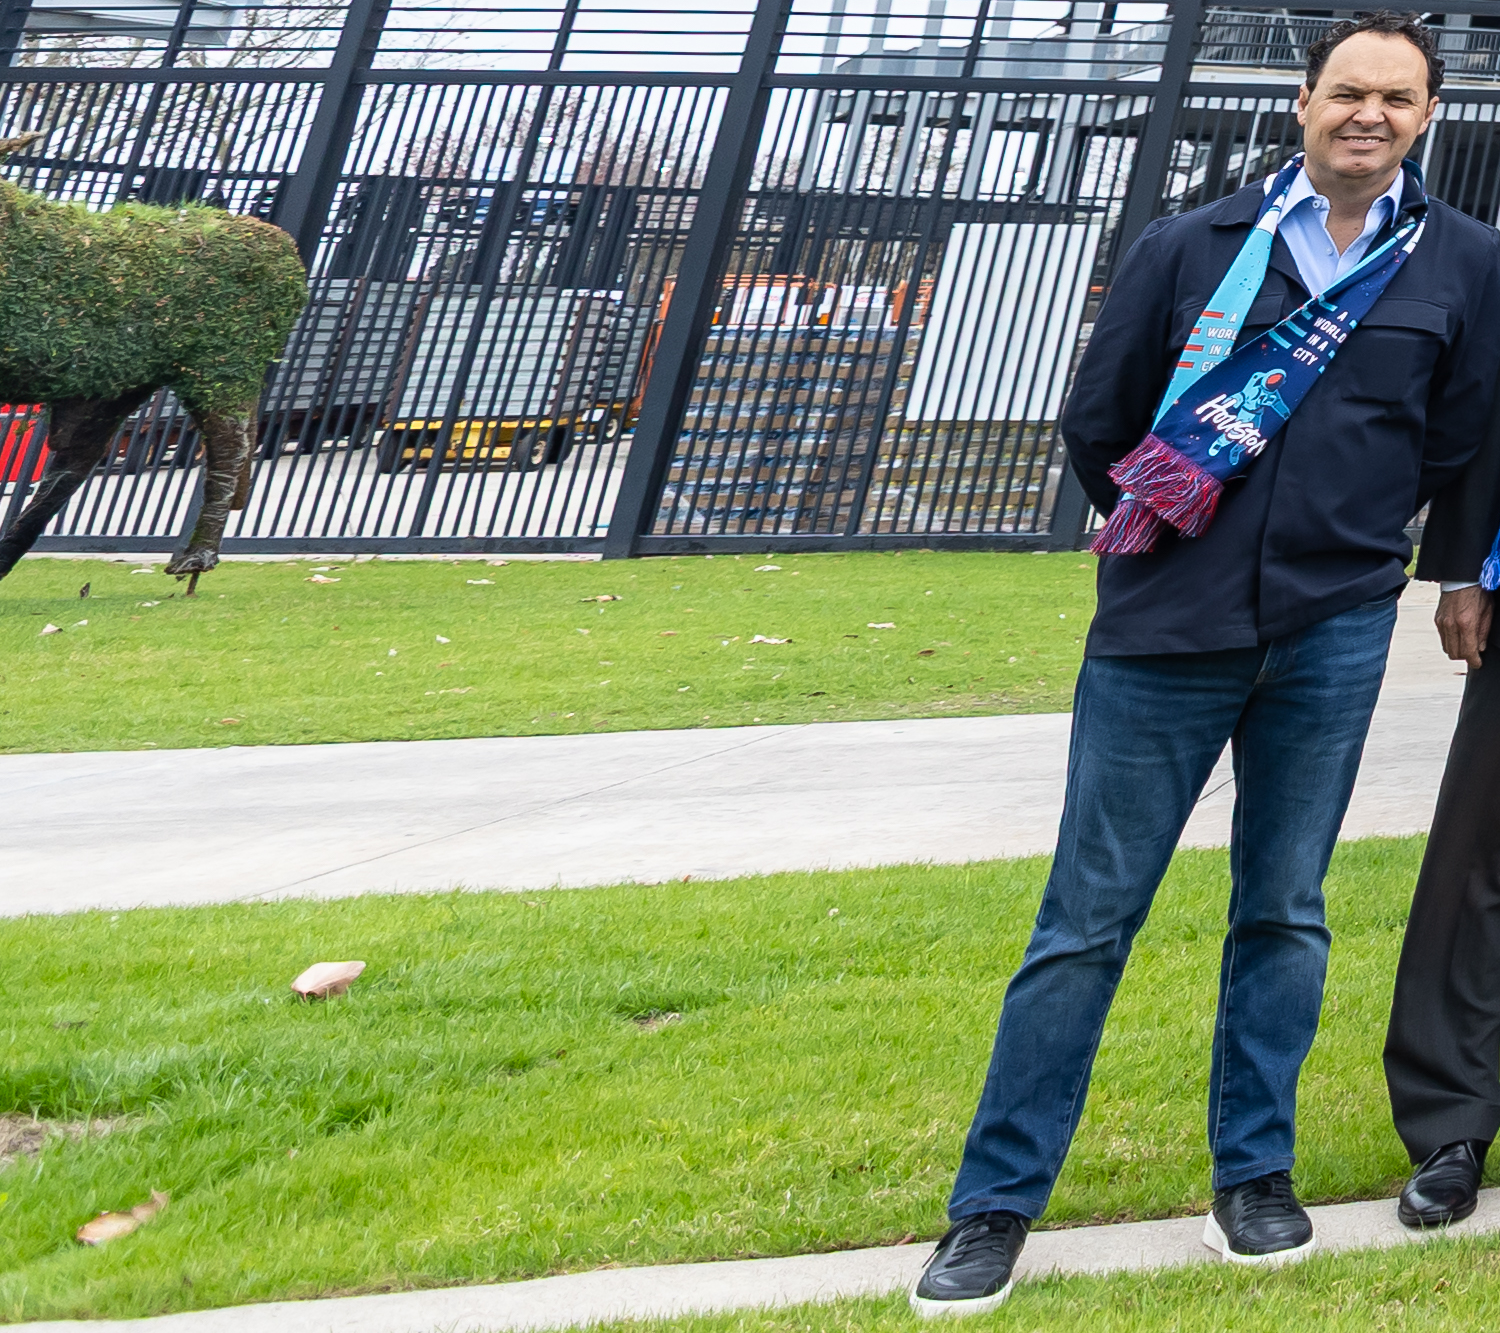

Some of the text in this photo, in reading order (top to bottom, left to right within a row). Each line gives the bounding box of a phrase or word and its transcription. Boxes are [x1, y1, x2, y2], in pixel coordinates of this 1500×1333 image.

[1228, 312, 1237, 323] A
[1337, 311, 1349, 321] A
[1206, 326, 1238, 341] WORL
[1314, 317, 1348, 344] WORLD
[1209, 344, 1221, 356] IN
[1306, 333, 1329, 352] IN A
[1292, 347, 1319, 366] CITY
